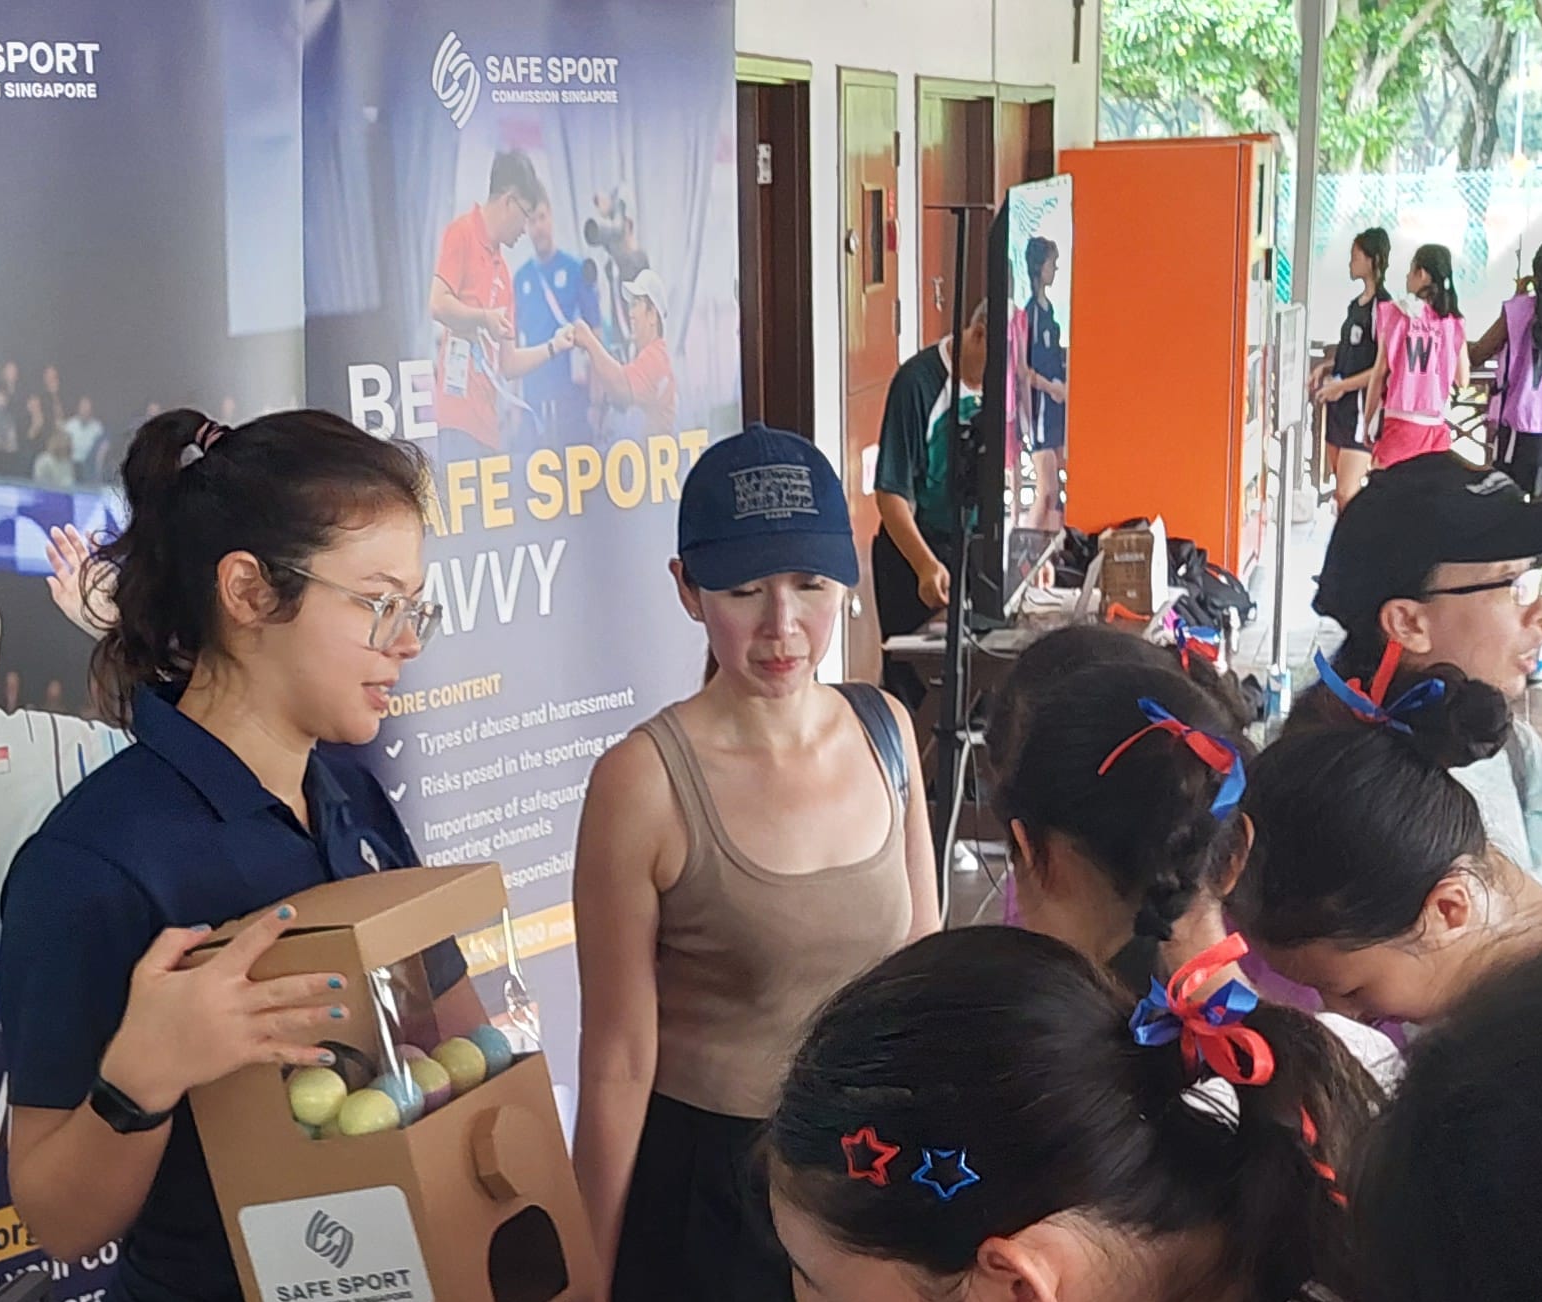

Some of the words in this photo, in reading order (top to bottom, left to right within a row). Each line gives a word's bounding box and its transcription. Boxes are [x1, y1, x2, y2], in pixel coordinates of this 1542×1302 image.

[5, 82, 98, 100] SINGAPORE
[485, 55, 542, 84] SAFE
[548, 56, 619, 86] SPORT
[491, 89, 559, 104] COMMISSION
[561, 90, 619, 104] SINGAPORE
[347, 360, 438, 441] BE
[526, 429, 709, 521] SPORT
[421, 538, 567, 638] AVVY
[429, 673, 503, 709] CONTENT
[416, 730, 462, 757] Types
[463, 720, 478, 743] of
[479, 714, 520, 739] abuse
[521, 702, 548, 729] and
[548, 686, 636, 722] harassment
[420, 771, 461, 798] Risks
[462, 756, 503, 791] posed
[504, 754, 519, 776] in
[520, 749, 543, 772] the
[544, 735, 605, 768] sporting
[424, 805, 503, 842] Importance
[504, 795, 519, 819] of
[426, 836, 492, 868] reporting
[493, 816, 554, 851] channels
[337, 1268, 411, 1294] SPORT
